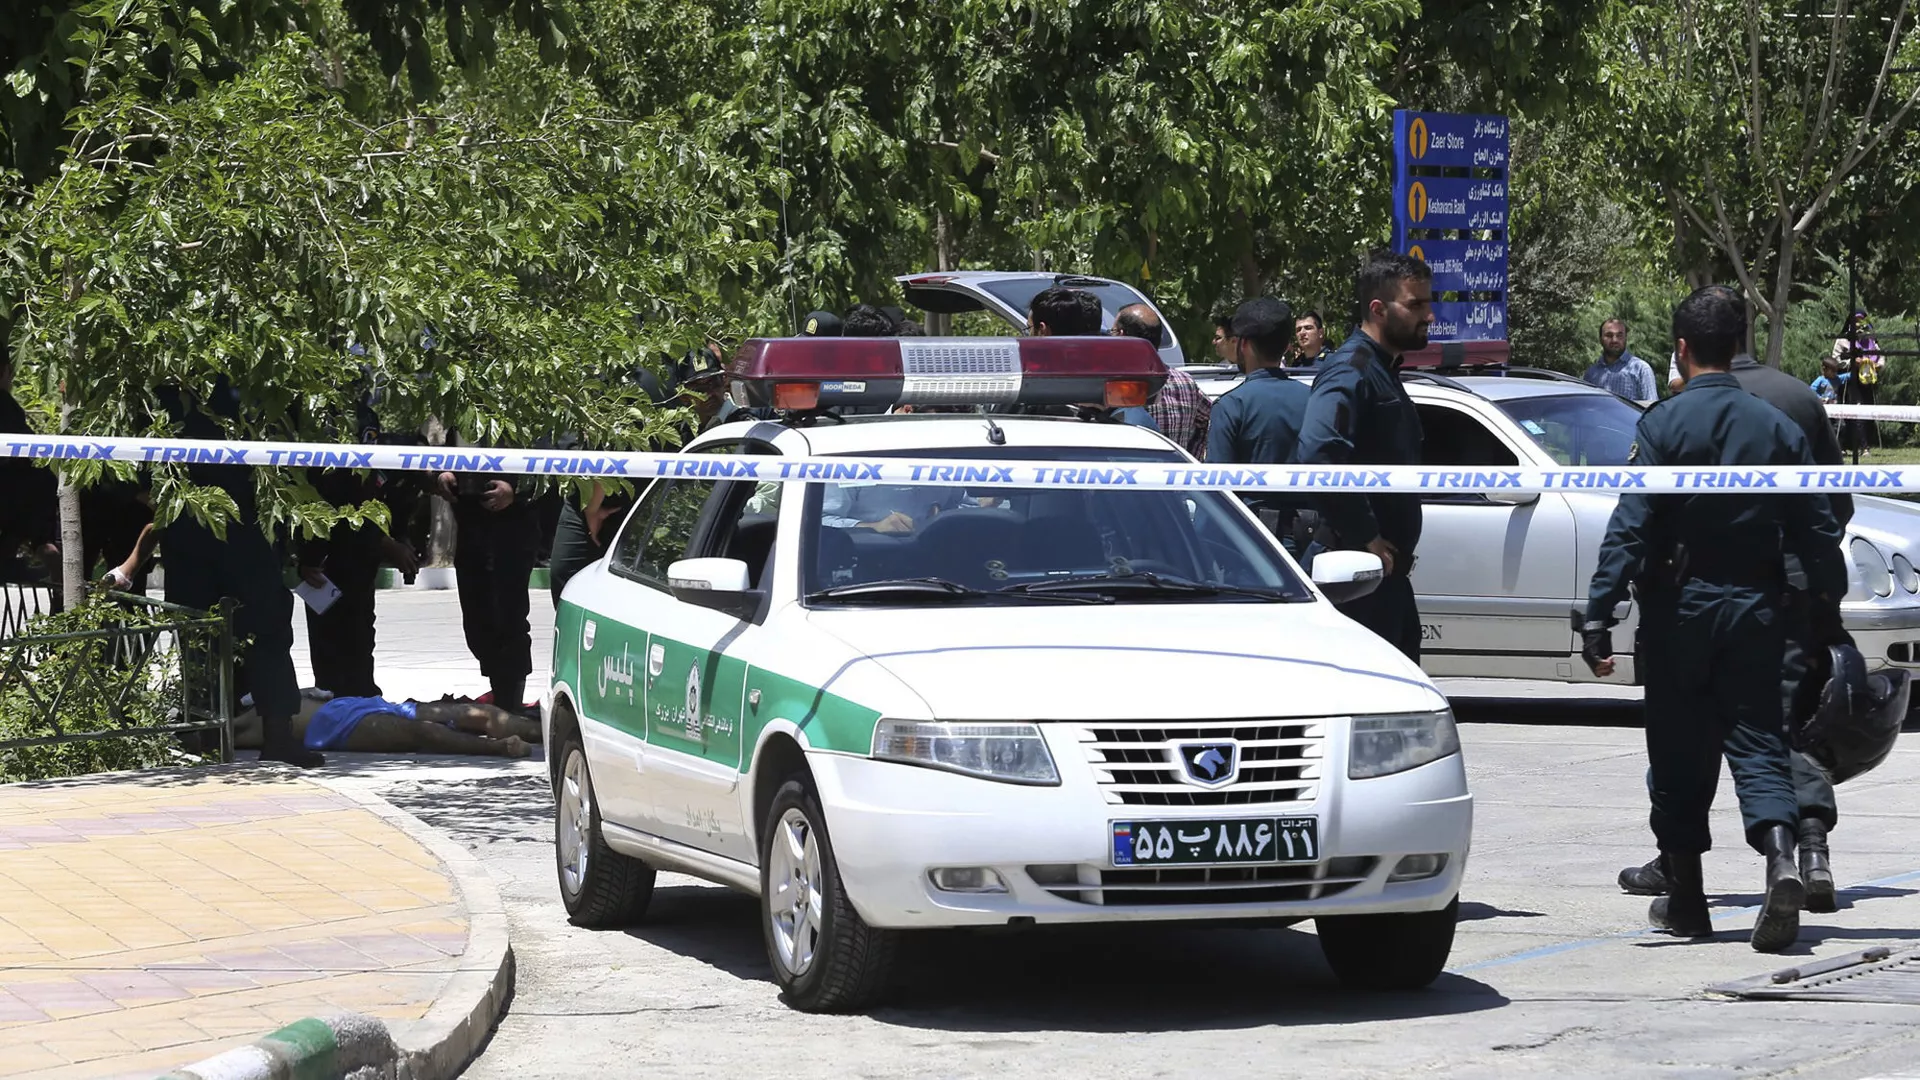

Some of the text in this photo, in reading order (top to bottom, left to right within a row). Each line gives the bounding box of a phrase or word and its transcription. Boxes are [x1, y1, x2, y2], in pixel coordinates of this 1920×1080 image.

[1431, 132, 1465, 149] Zaer Store
[1454, 198, 1466, 214] Bank
[1465, 302, 1487, 328] آفتاب
[1443, 322, 1458, 336] Hotel
[6, 442, 1904, 489] TRINX TRINX TRINX TRINX TRINX TRINX TRINX TRINX TRINX TRINX TRINX TRINX TRINX TRINX TRINX
[598, 641, 634, 706] پلیس
[1281, 820, 1312, 828] ایران
